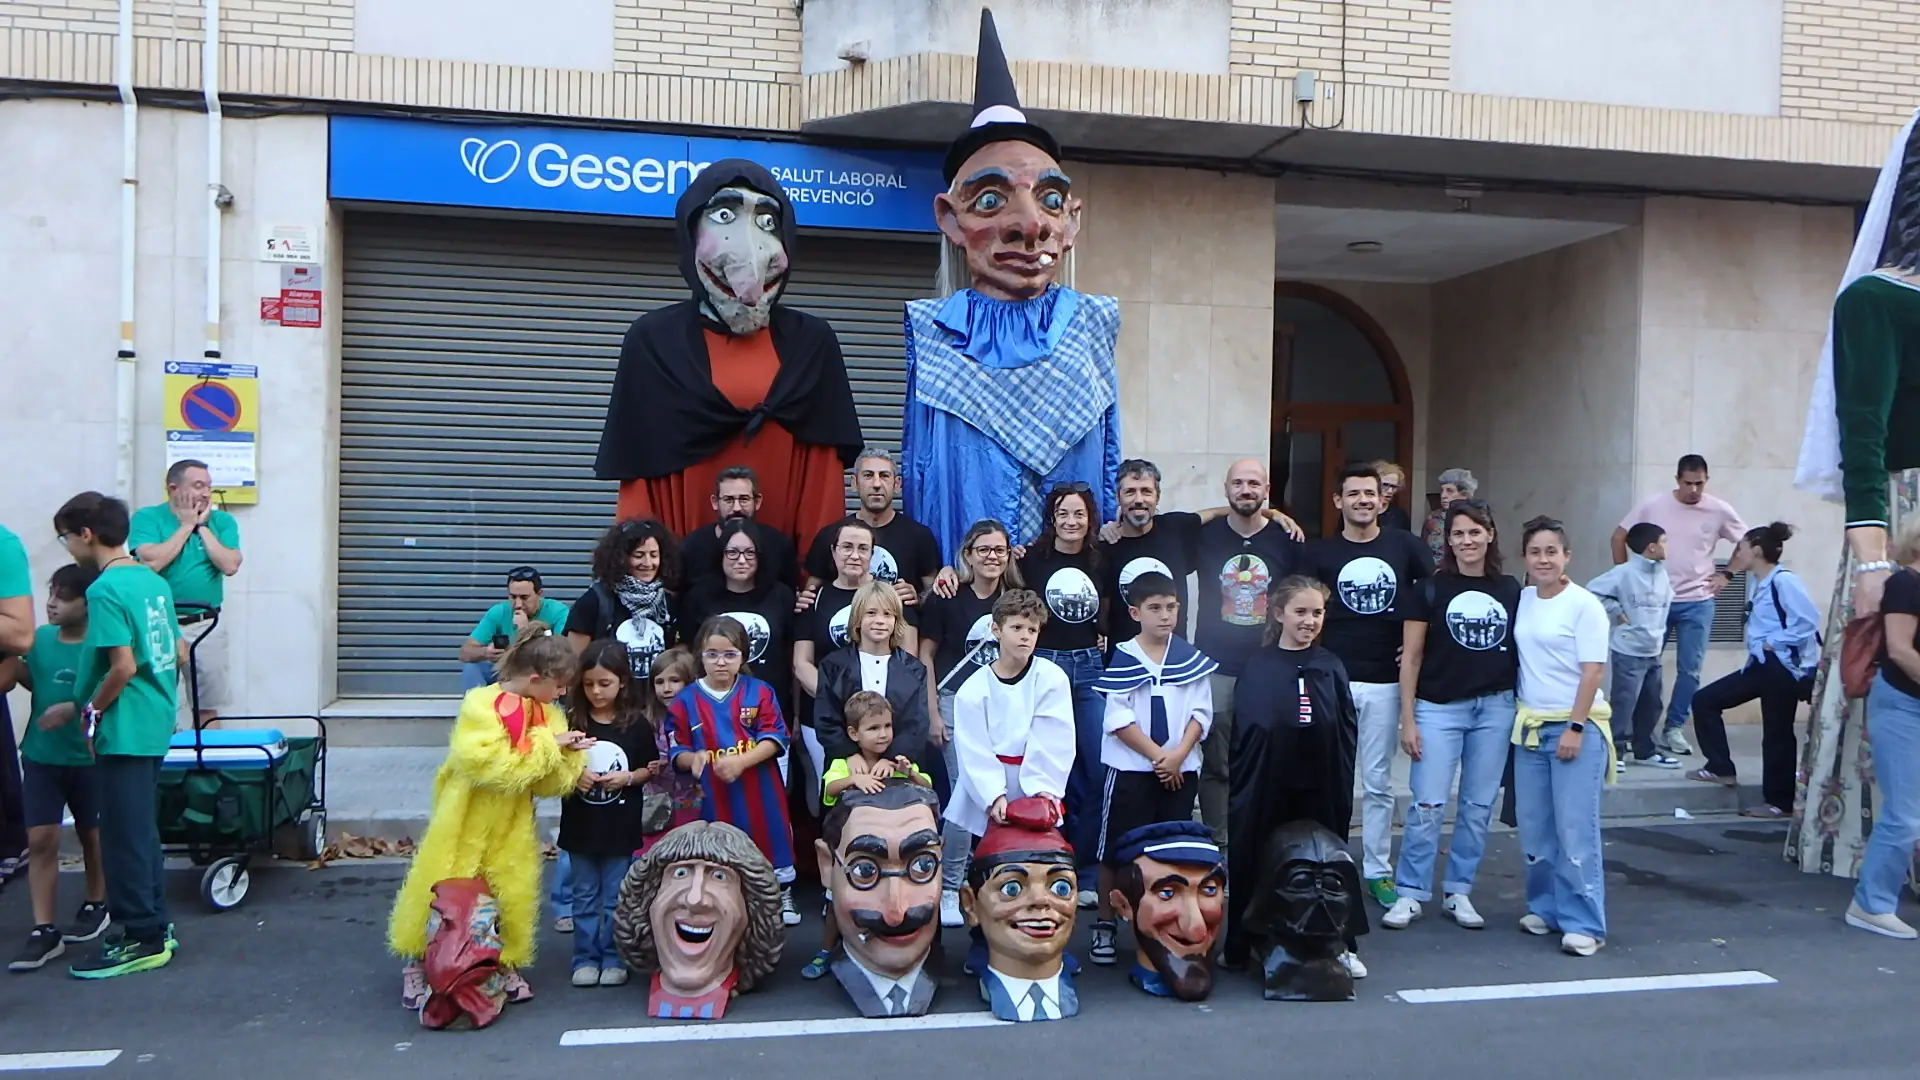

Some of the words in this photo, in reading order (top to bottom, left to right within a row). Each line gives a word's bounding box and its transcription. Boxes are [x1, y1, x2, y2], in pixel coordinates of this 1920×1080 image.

[527, 142, 713, 195] Gesem
[770, 166, 825, 184] SALUT
[829, 171, 907, 189] LABORAL
